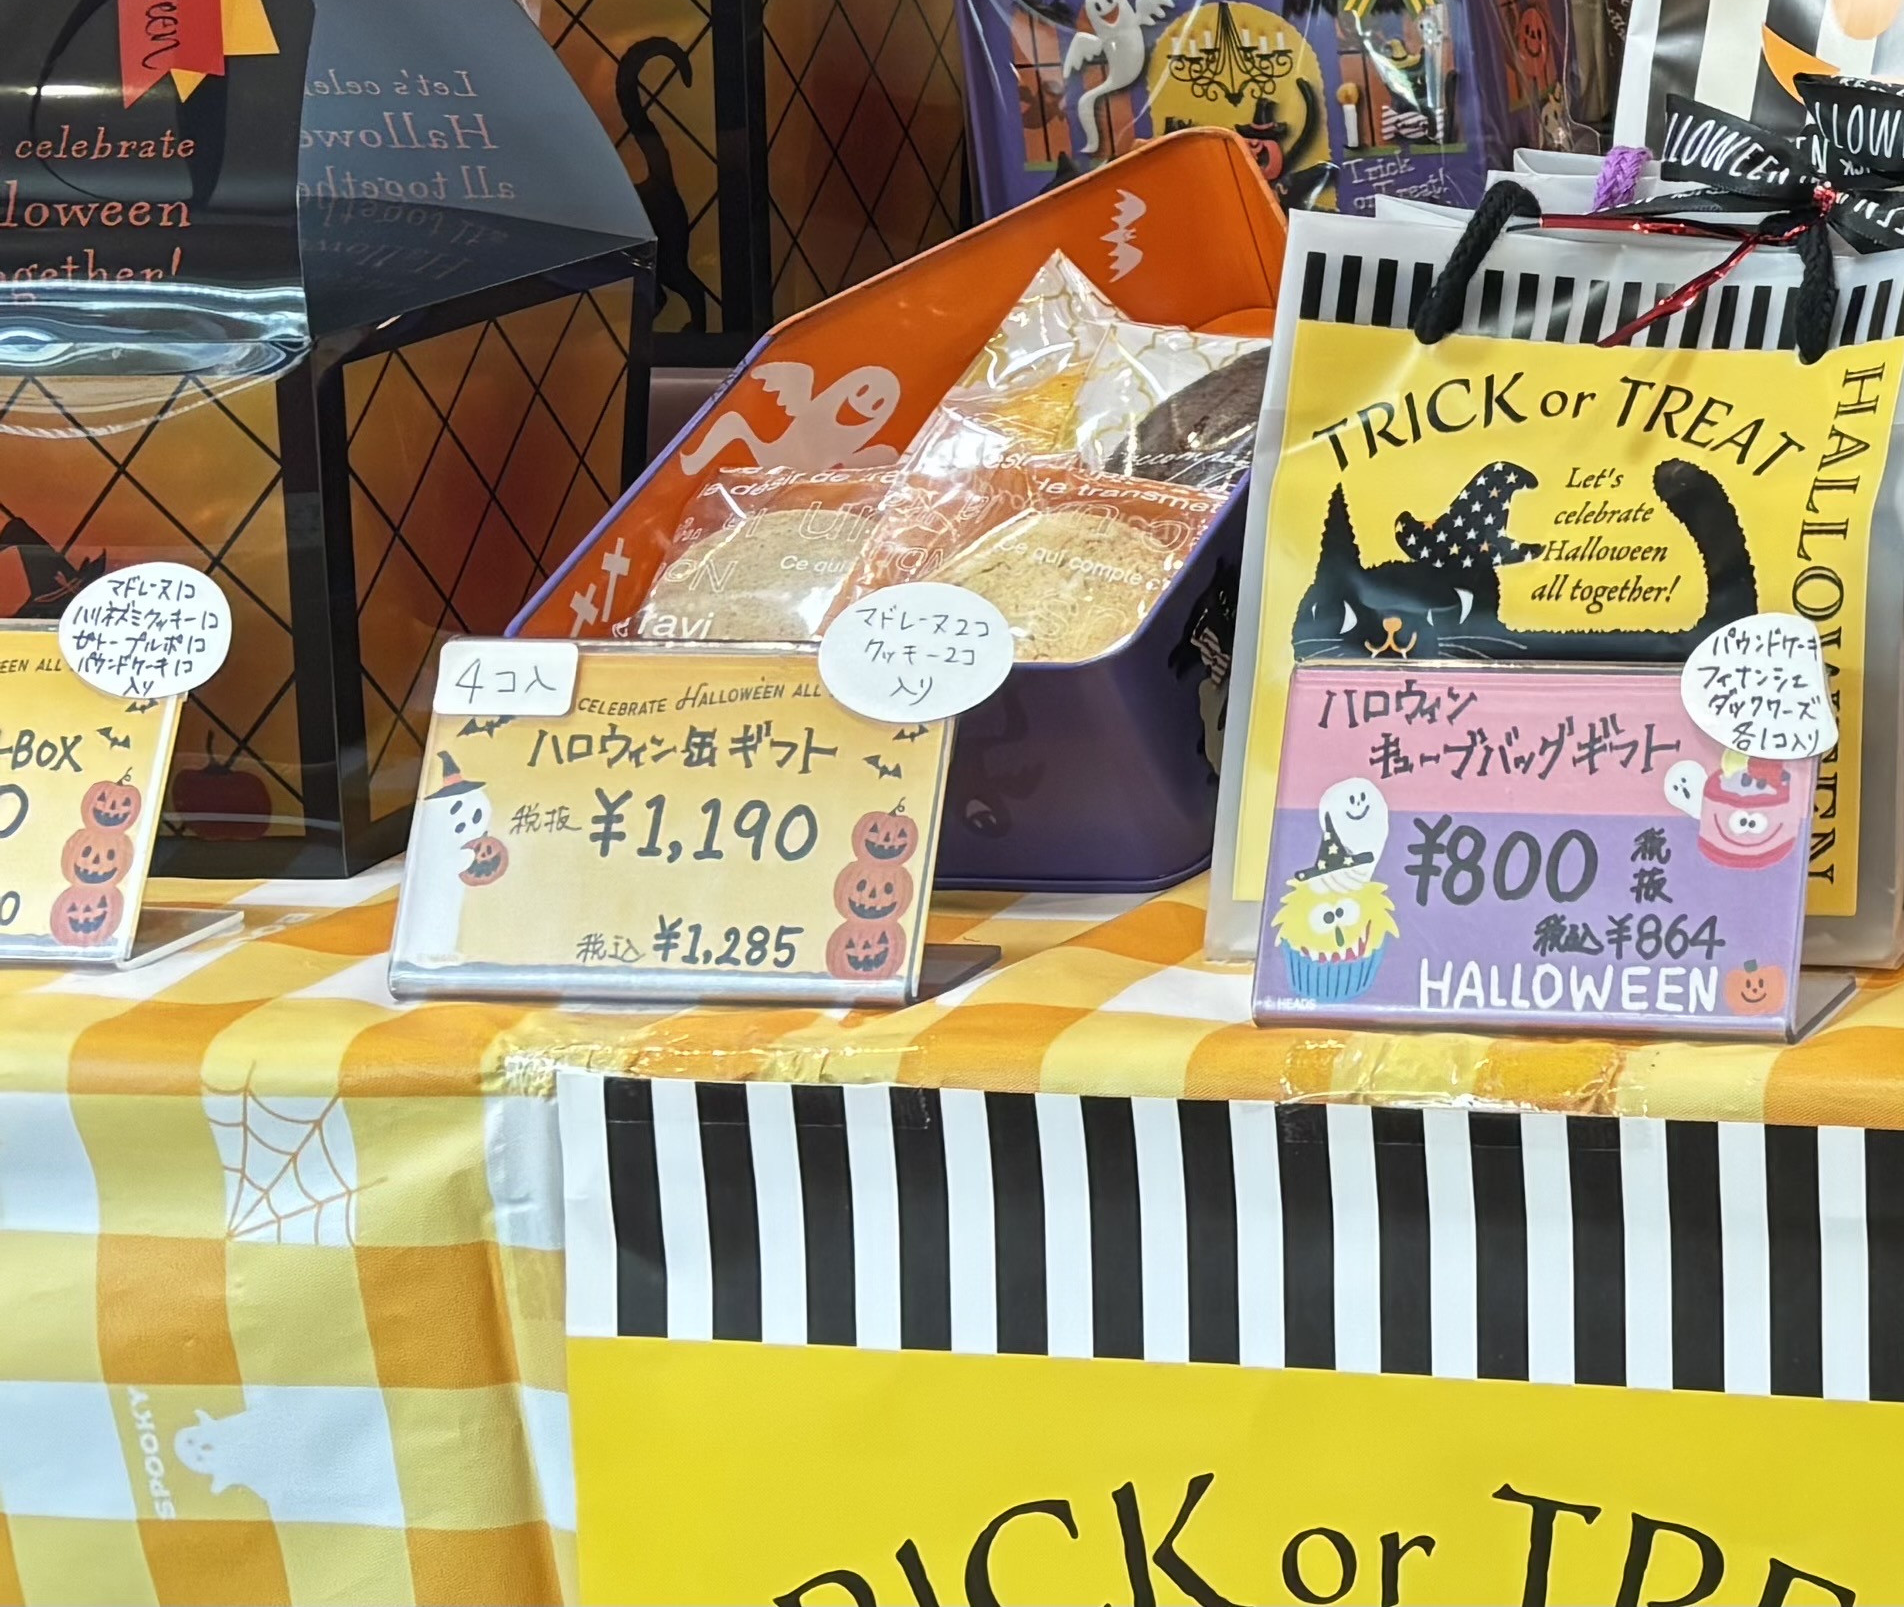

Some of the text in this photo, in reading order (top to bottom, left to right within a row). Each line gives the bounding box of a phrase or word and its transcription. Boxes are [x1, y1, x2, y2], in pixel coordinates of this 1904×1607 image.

[15, 127, 196, 161] celebrate
[1342, 150, 1415, 183] Trick
[1313, 370, 1525, 473] TRICK
[1539, 388, 1595, 421] or
[1618, 375, 1807, 478] TREAT
[1565, 466, 1625, 491] Let's
[1553, 501, 1655, 526] celebrate
[780, 555, 808, 571] Ce
[1068, 555, 1143, 585] compte
[1542, 539, 1668, 565] Halloween
[1531, 574, 1681, 614] all together!
[637, 611, 715, 640] ravi
[35, 658, 63, 672] ALL
[454, 658, 557, 695] 4コ入
[577, 681, 822, 717] CELEBRATE HALLOWEEN ALL
[1317, 679, 1478, 729] ハロウィン
[526, 720, 839, 775] ハロウィン缶ギフト
[1368, 713, 1681, 780] キューブバッグギフト
[589, 786, 820, 864] ¥1,190
[1404, 813, 1599, 907] ¥800
[652, 914, 805, 968] ¥1,285
[1605, 914, 1725, 961] ¥864
[1418, 958, 1718, 1014] HALLOWEEN
[127, 1385, 177, 1520] SPOOKY
[1278, 1525, 1436, 1606] or
